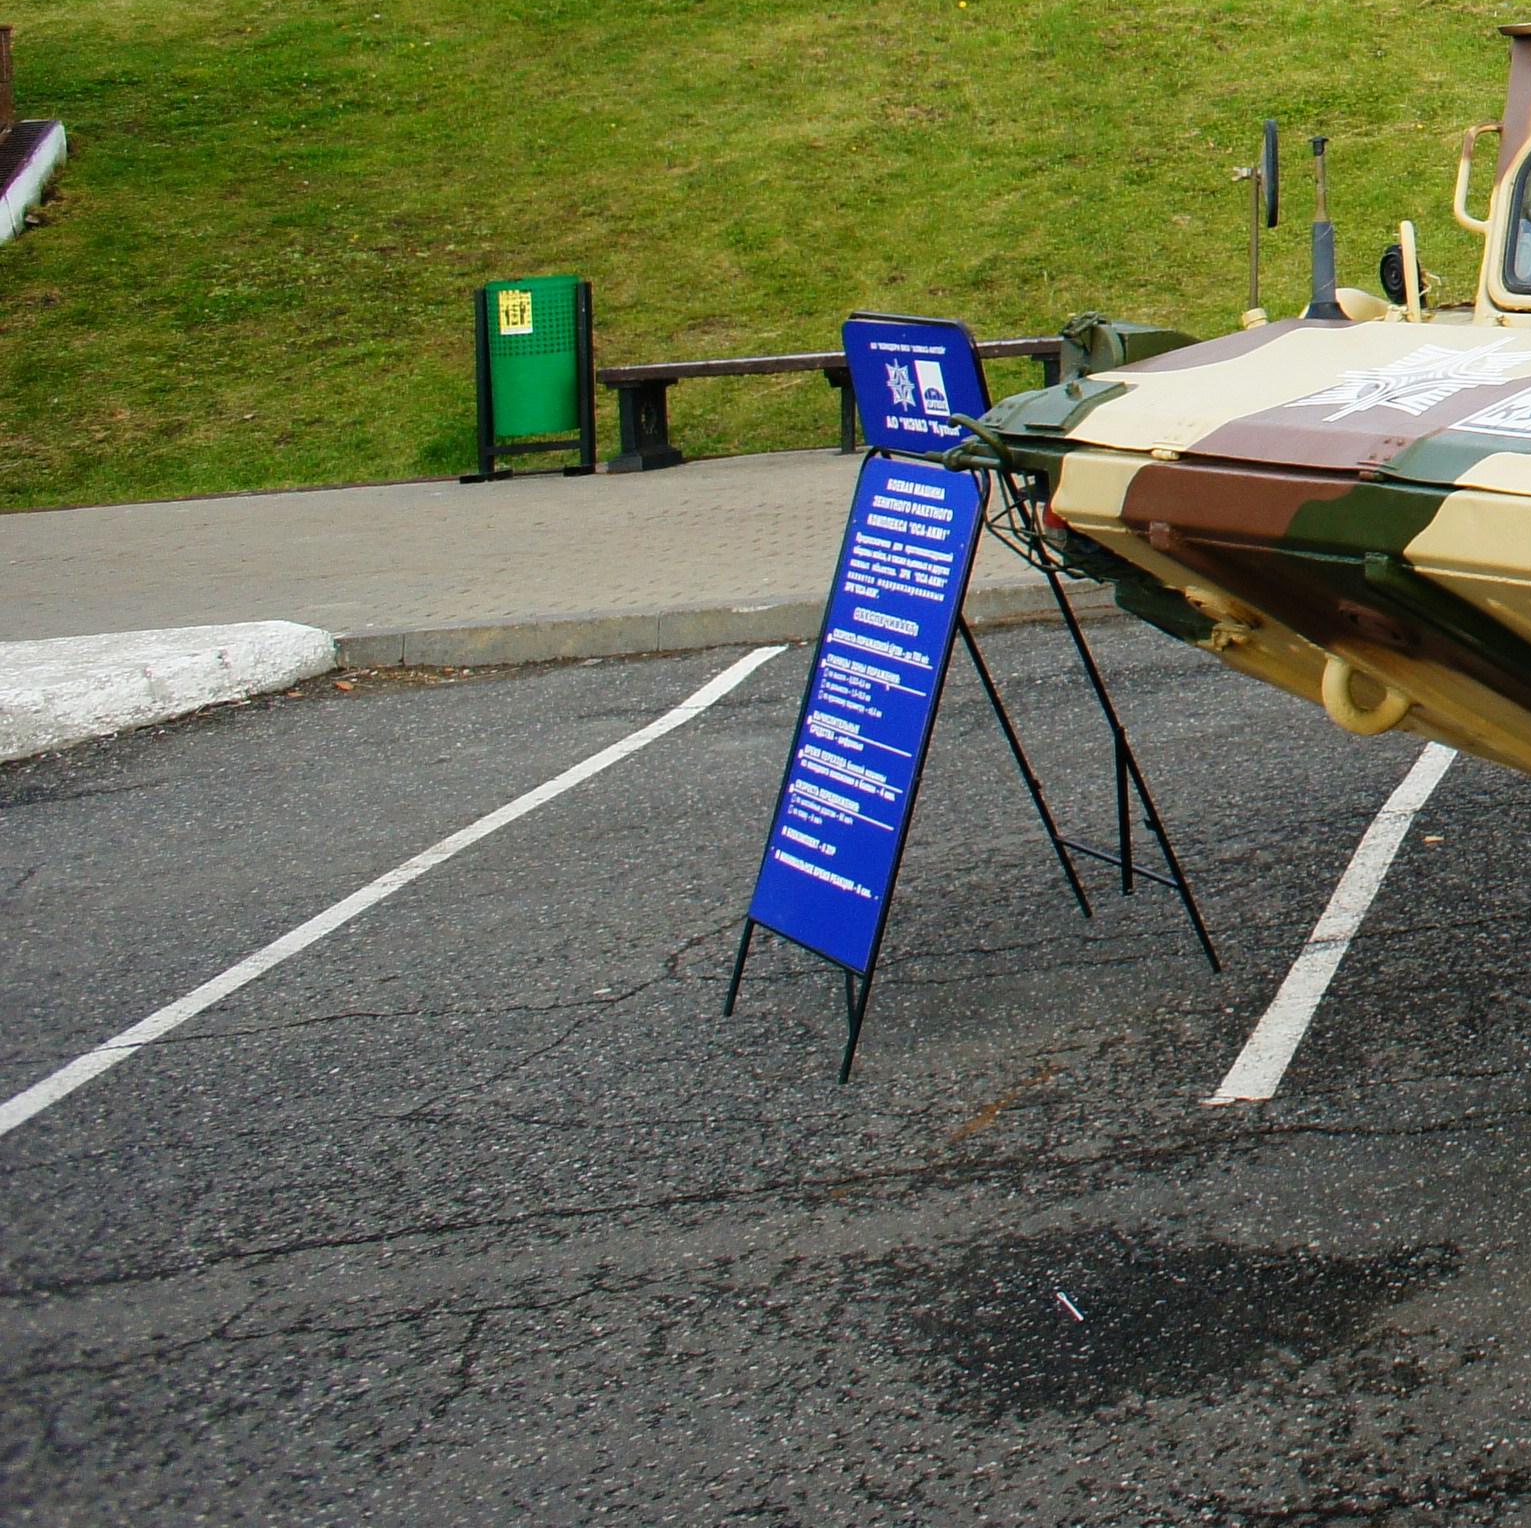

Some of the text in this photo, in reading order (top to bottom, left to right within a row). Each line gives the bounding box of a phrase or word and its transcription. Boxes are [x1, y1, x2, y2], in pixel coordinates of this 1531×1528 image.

[885, 416, 899, 427] АО
[872, 495, 954, 520] ЗЕНИТНОГО РАКЕТНОГО
